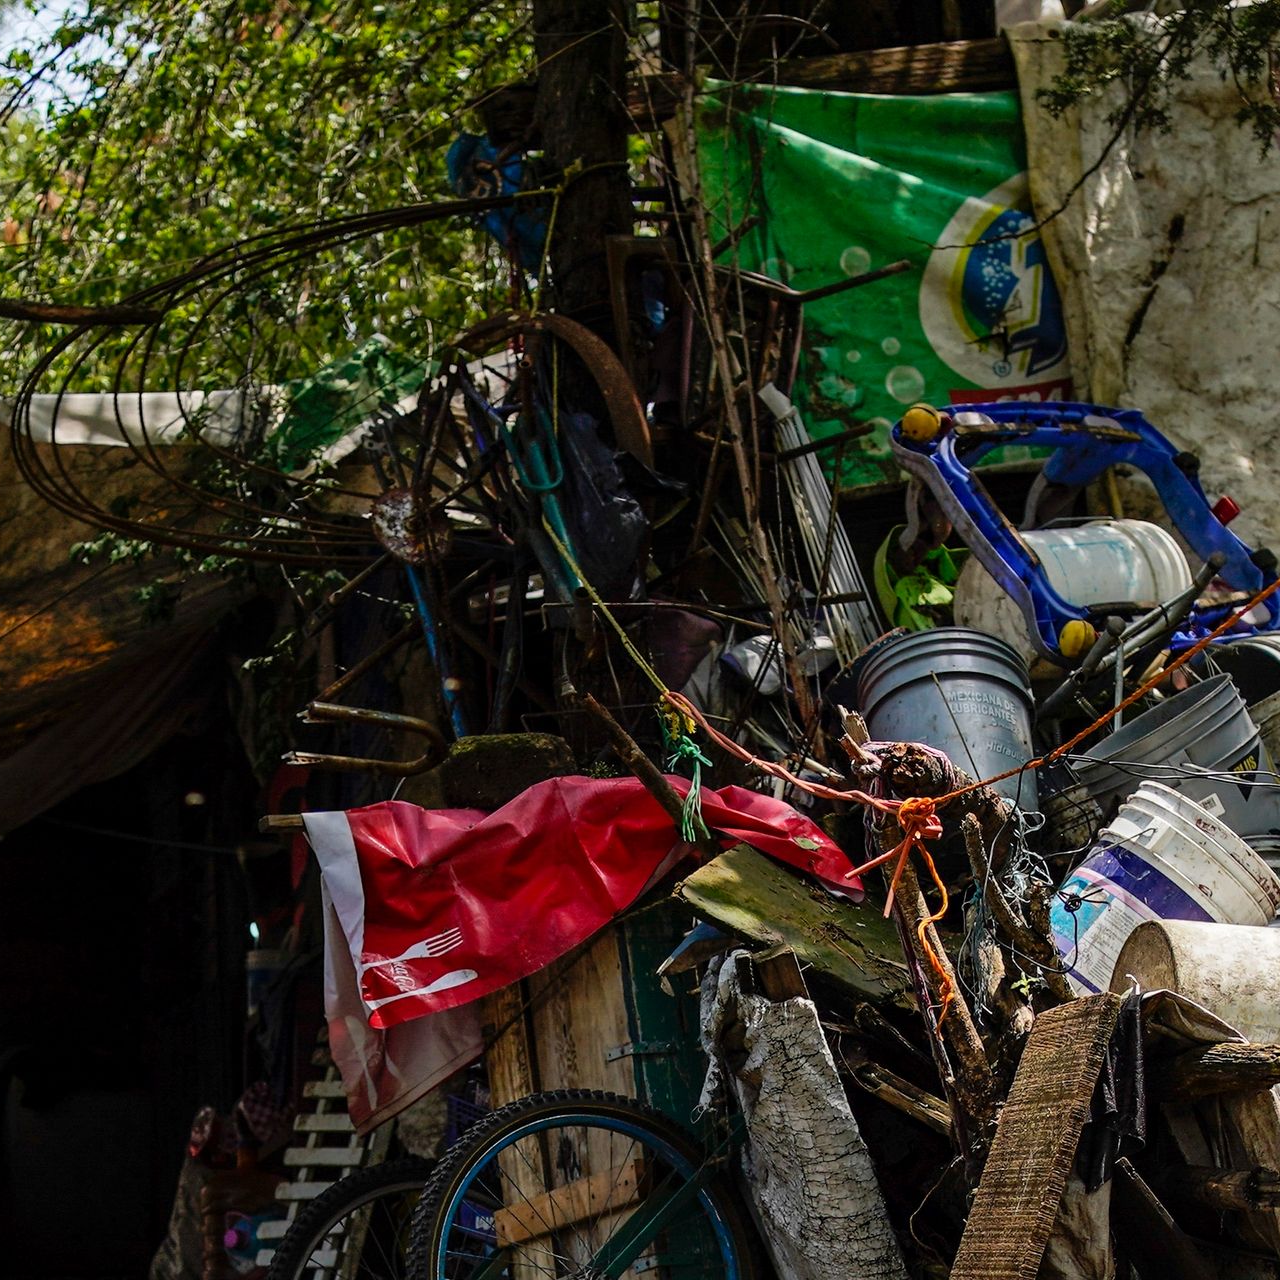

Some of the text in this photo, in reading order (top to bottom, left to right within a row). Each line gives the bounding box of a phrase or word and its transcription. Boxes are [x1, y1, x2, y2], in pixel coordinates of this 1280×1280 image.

[947, 691, 1016, 713] MEXICANA DE
[949, 702, 1017, 725] LUBRICANTES
